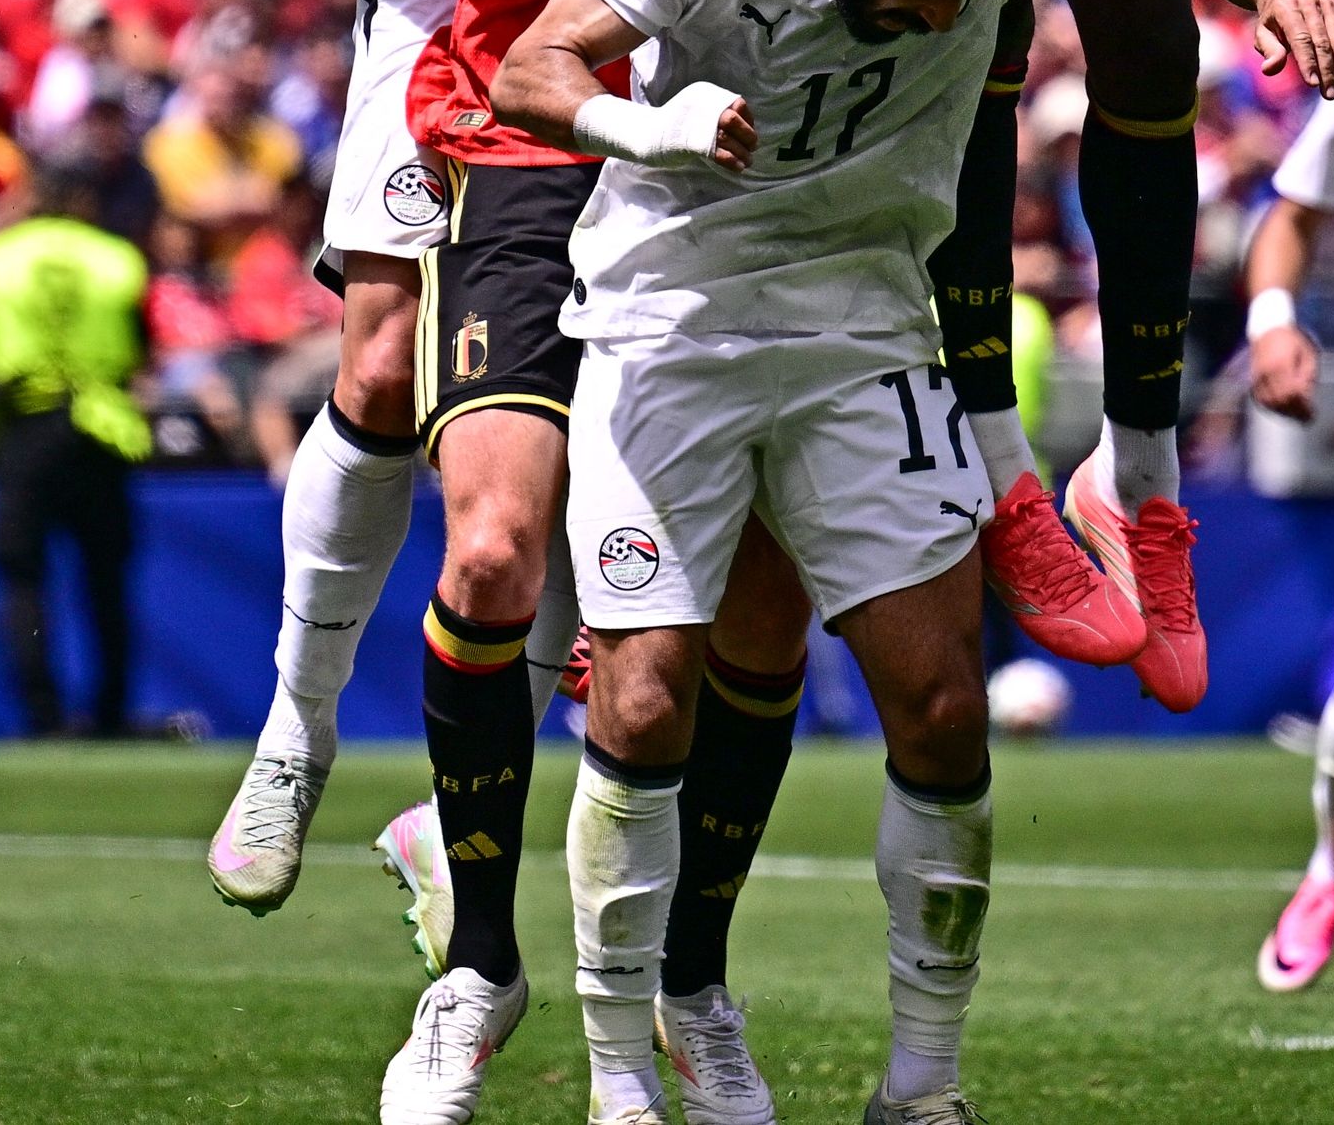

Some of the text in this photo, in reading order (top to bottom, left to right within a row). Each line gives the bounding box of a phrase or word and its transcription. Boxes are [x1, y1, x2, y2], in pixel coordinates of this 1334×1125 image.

[776, 56, 899, 162] 17
[1133, 311, 1192, 337] RBF
[878, 363, 969, 474] 17
[429, 759, 514, 793] BFA
